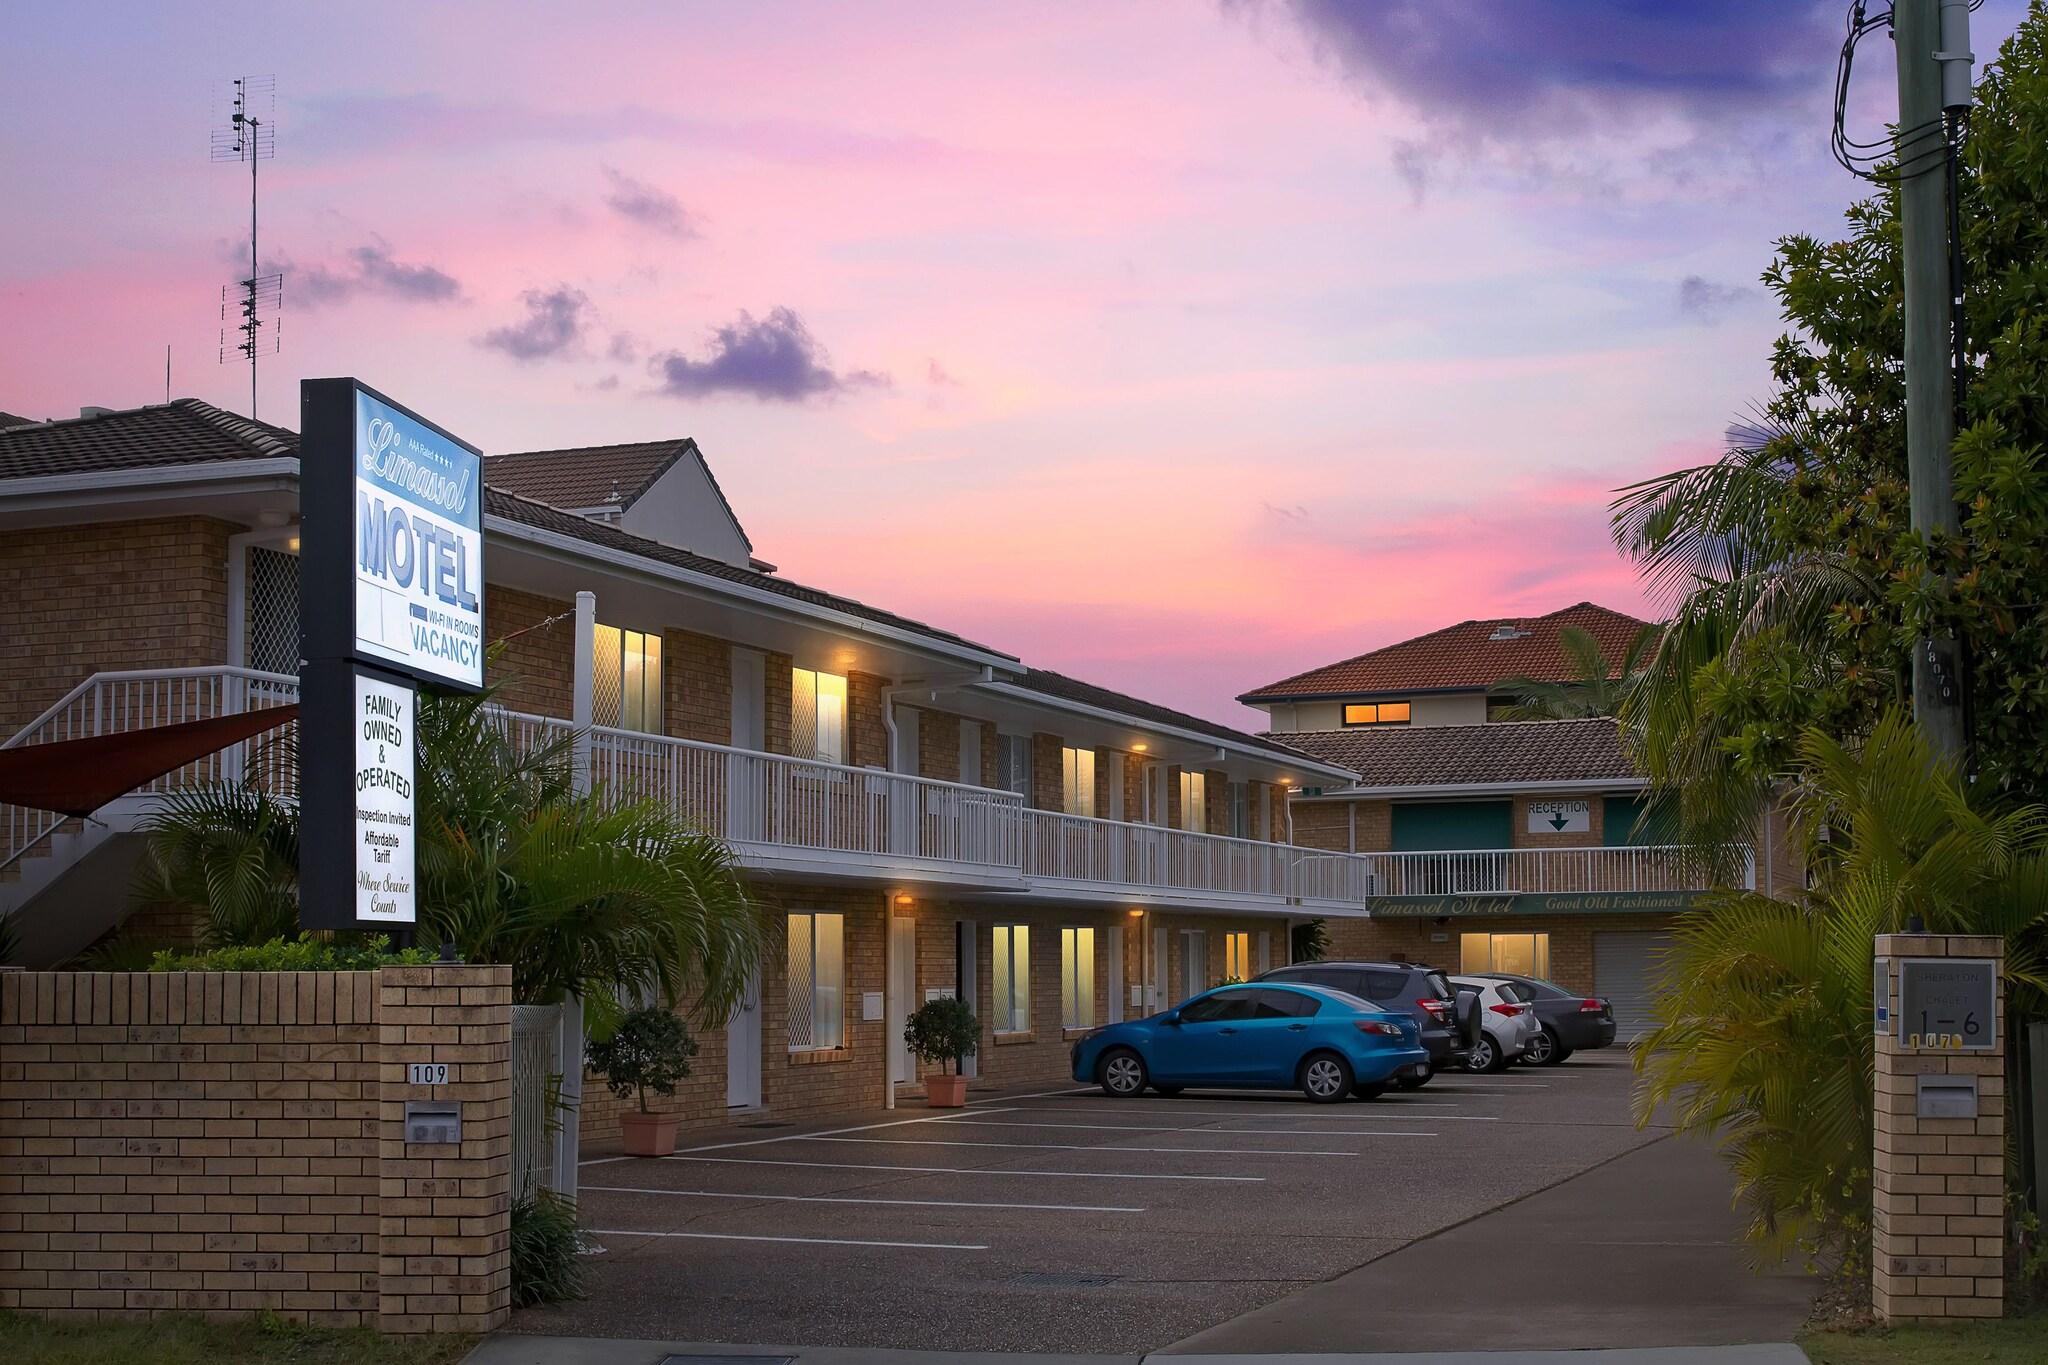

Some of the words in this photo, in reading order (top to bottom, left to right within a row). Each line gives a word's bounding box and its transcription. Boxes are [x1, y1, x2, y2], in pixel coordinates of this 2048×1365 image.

[363, 418, 470, 514] Limassol
[357, 490, 479, 614] MOTEL
[454, 619, 479, 638] ROOMS
[410, 622, 479, 668] VACANCY
[365, 695, 402, 722] FAMILY
[364, 720, 402, 747] OWNED
[378, 744, 386, 763] &
[356, 767, 411, 799] OPERATED
[356, 805, 388, 823] Inspection
[389, 811, 411, 827] Invited
[1528, 801, 1589, 814] RECEPTION
[364, 830, 400, 848] Affordable
[373, 848, 391, 863] Tariff
[357, 870, 381, 892] Where
[382, 873, 410, 894] Service
[370, 893, 397, 914] Counts
[1546, 898, 1581, 911] Good
[1584, 896, 1609, 910] Old
[1612, 895, 1684, 910] Fashioned
[414, 1065, 446, 1083] 109
